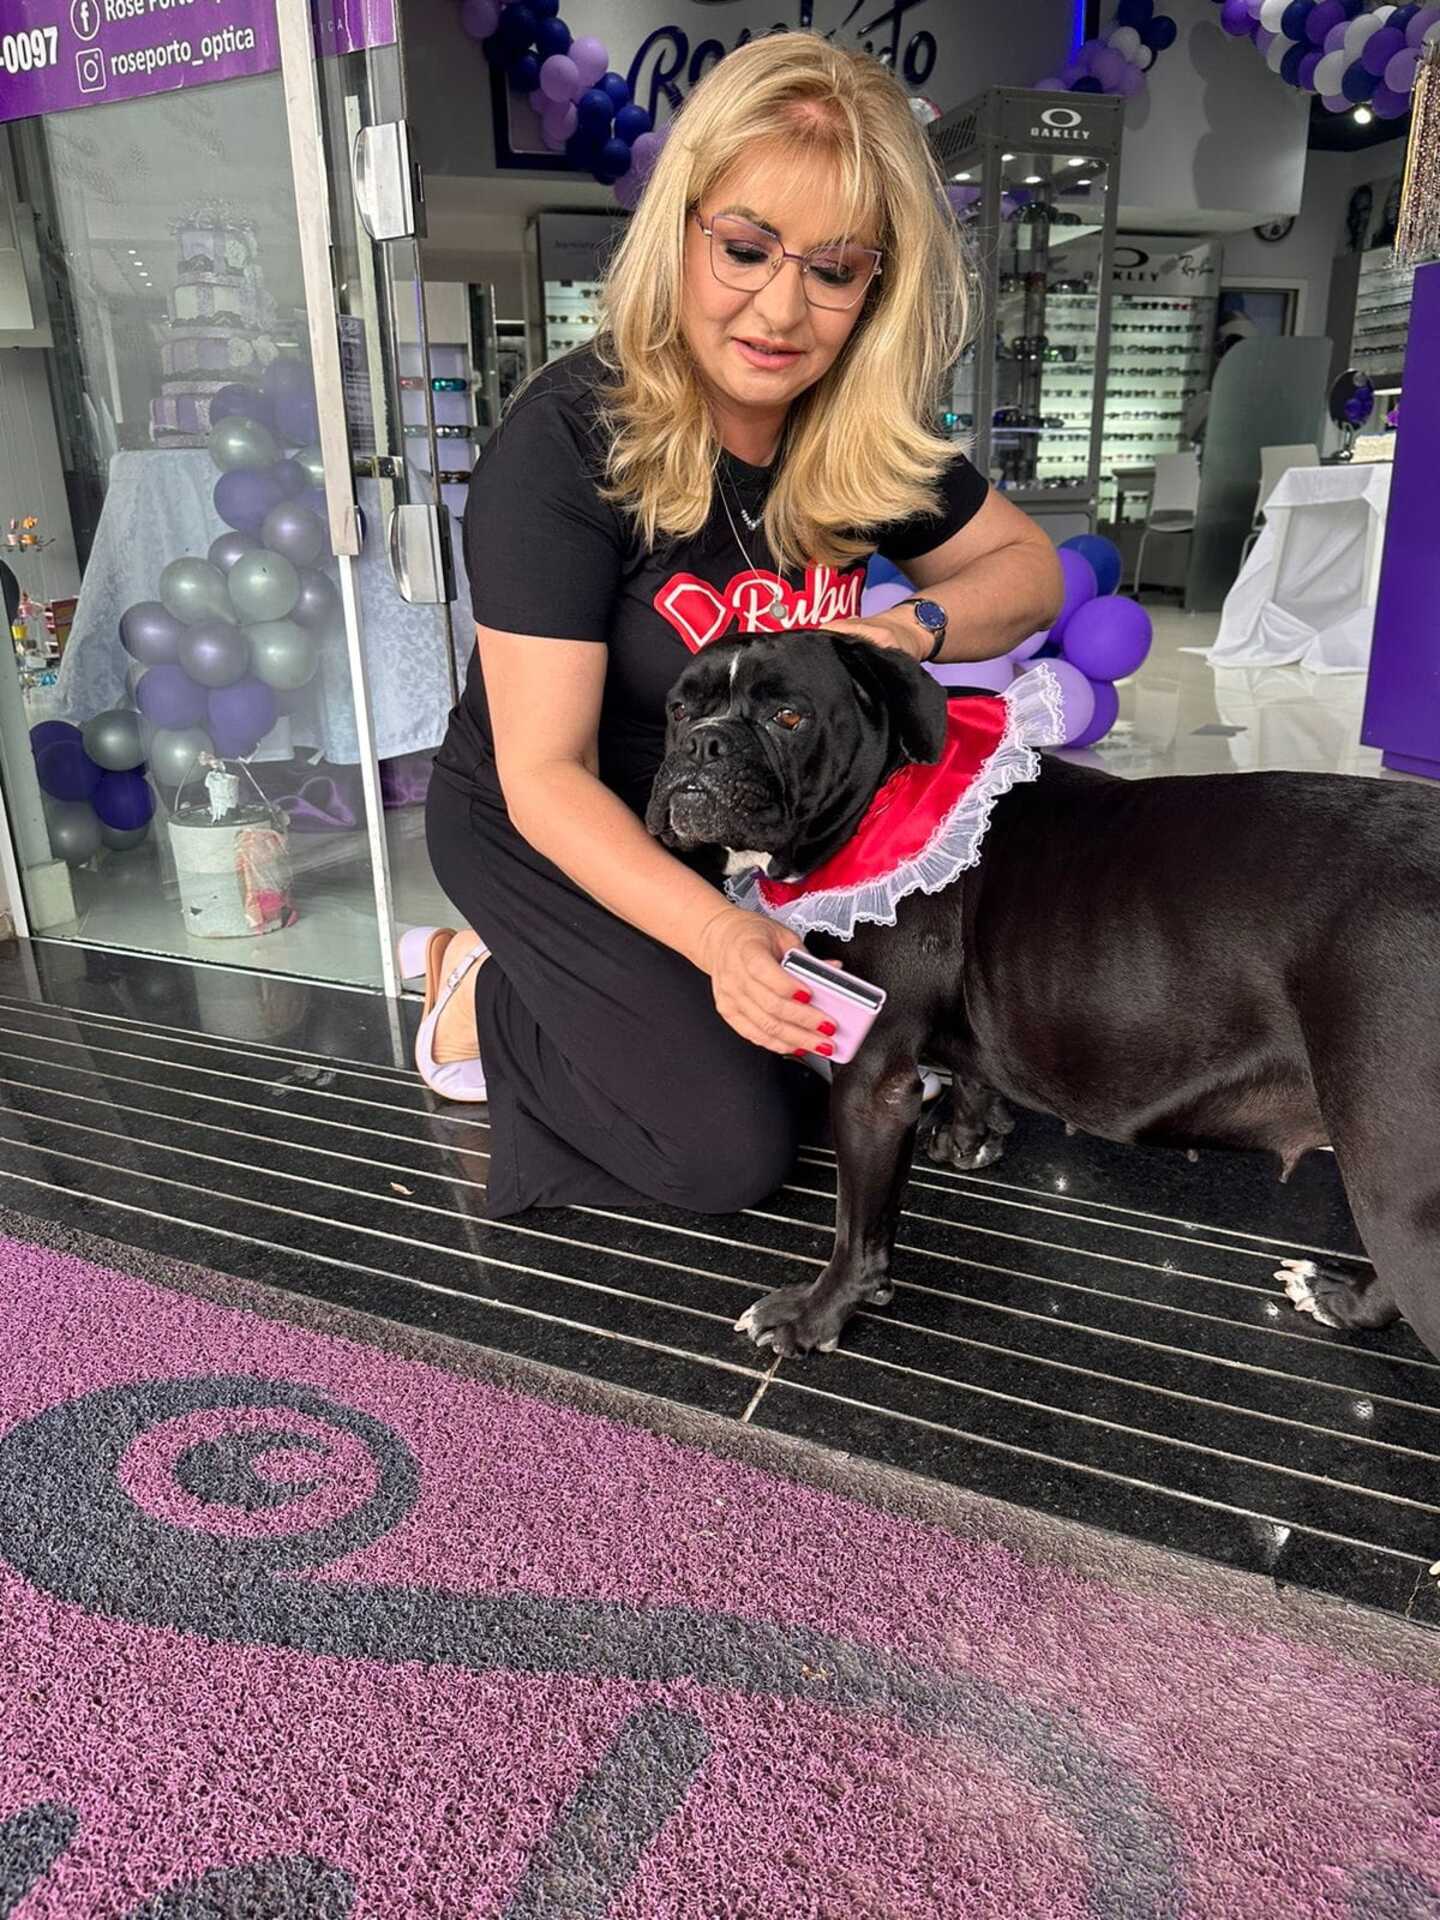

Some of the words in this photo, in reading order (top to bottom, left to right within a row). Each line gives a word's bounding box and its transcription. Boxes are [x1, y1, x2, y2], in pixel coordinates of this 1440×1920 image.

[105, 0, 144, 22] Rose
[111, 25, 254, 76] roseporto_optica
[1030, 127, 1090, 140] OAKLEY
[732, 563, 859, 632] Ruby
